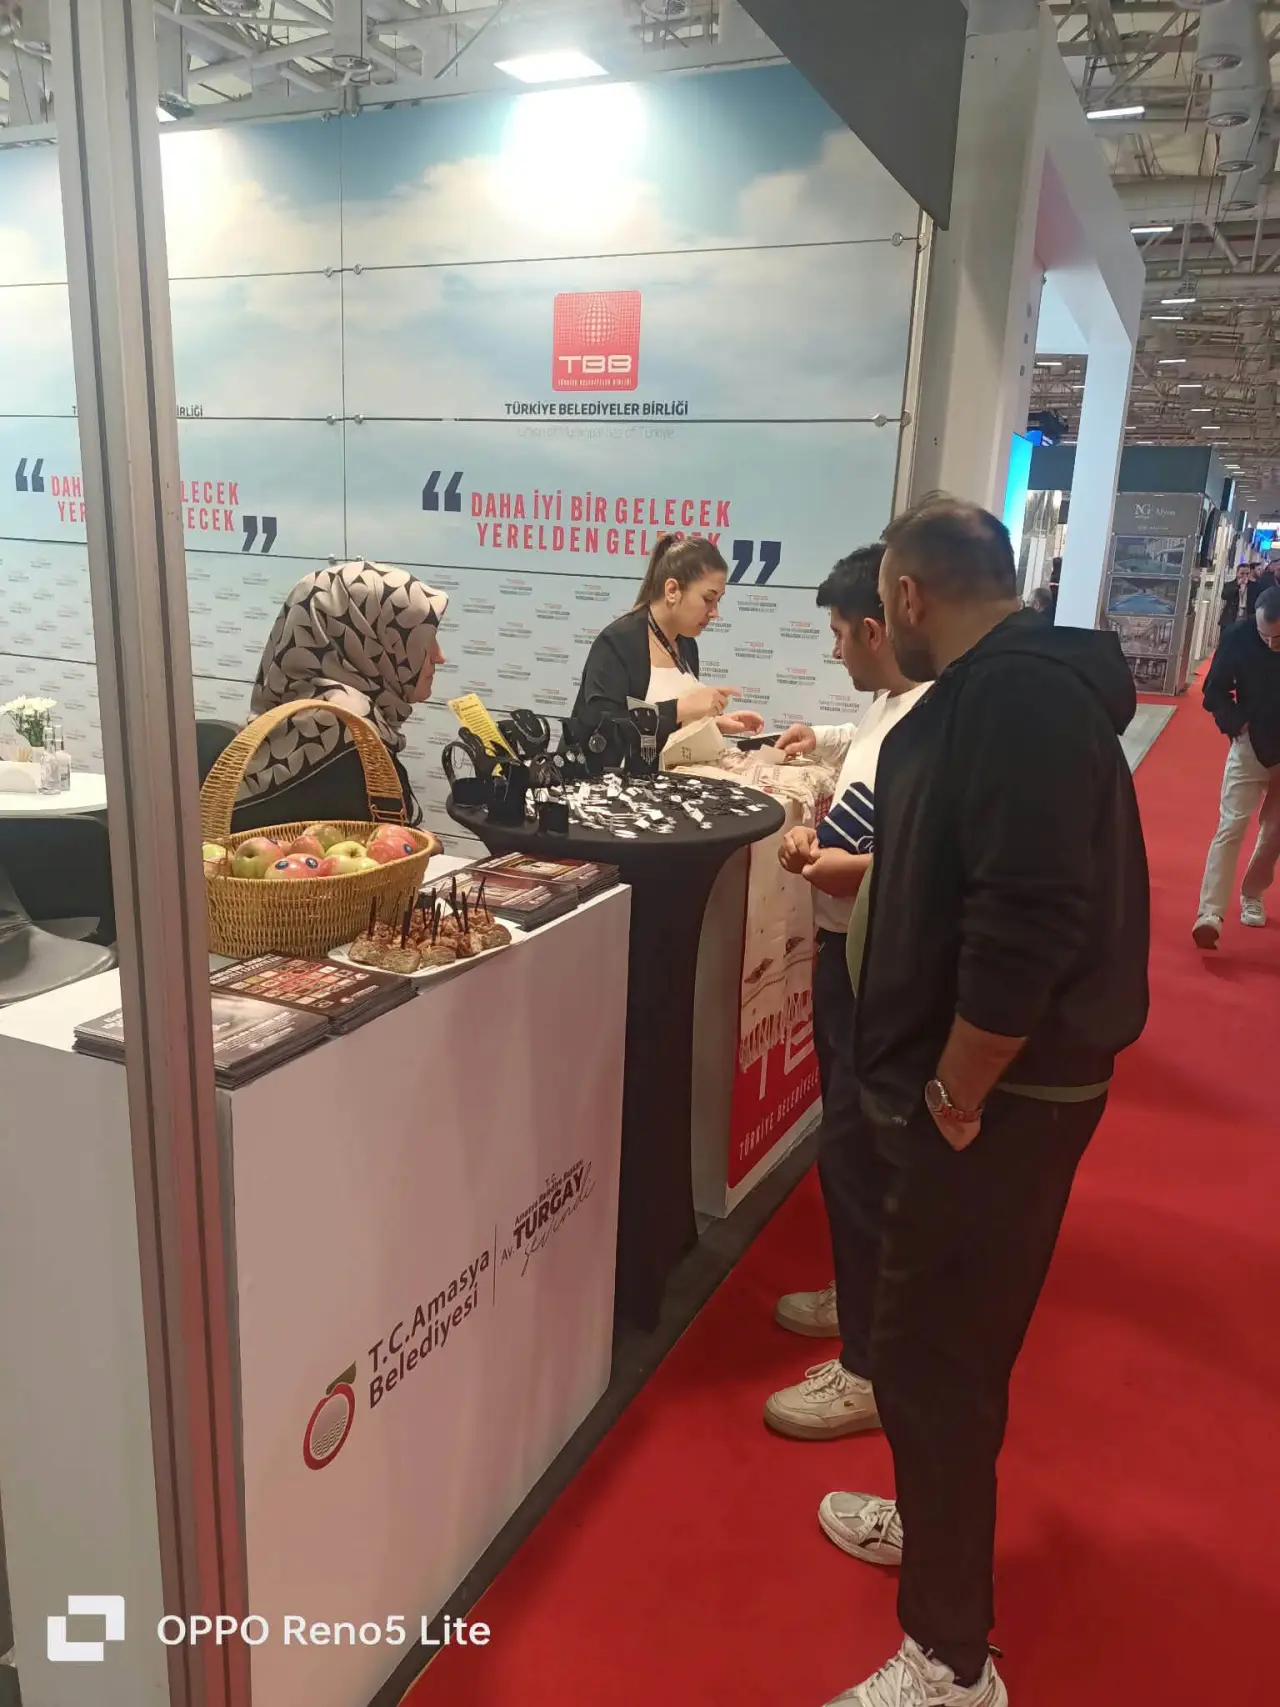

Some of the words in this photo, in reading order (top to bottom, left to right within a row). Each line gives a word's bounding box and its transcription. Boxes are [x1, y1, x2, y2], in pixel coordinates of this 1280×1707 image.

[558, 354, 632, 374] TBB
[176, 404, 203, 417] İRLİĞİ
[505, 401, 556, 416] TÜRKİYE
[558, 401, 640, 416] BELEDİYELER
[642, 401, 689, 416] BİRLİĞİ
[51, 475, 83, 497] DAH
[180, 481, 240, 506] LECEK
[187, 507, 236, 532] ECEK
[471, 491, 526, 519] DAHA
[533, 489, 562, 521] İYİ
[570, 491, 607, 523] BİR
[614, 498, 731, 527] GELECEK
[477, 522, 599, 553] YERELDEN
[606, 528, 721, 556] GELK
[739, 1110, 776, 1161] TÜRKİYE
[777, 1066, 820, 1123] BELEDİYELE
[513, 1166, 585, 1250] TURGAY
[369, 1282, 478, 1409] Belediyesi
